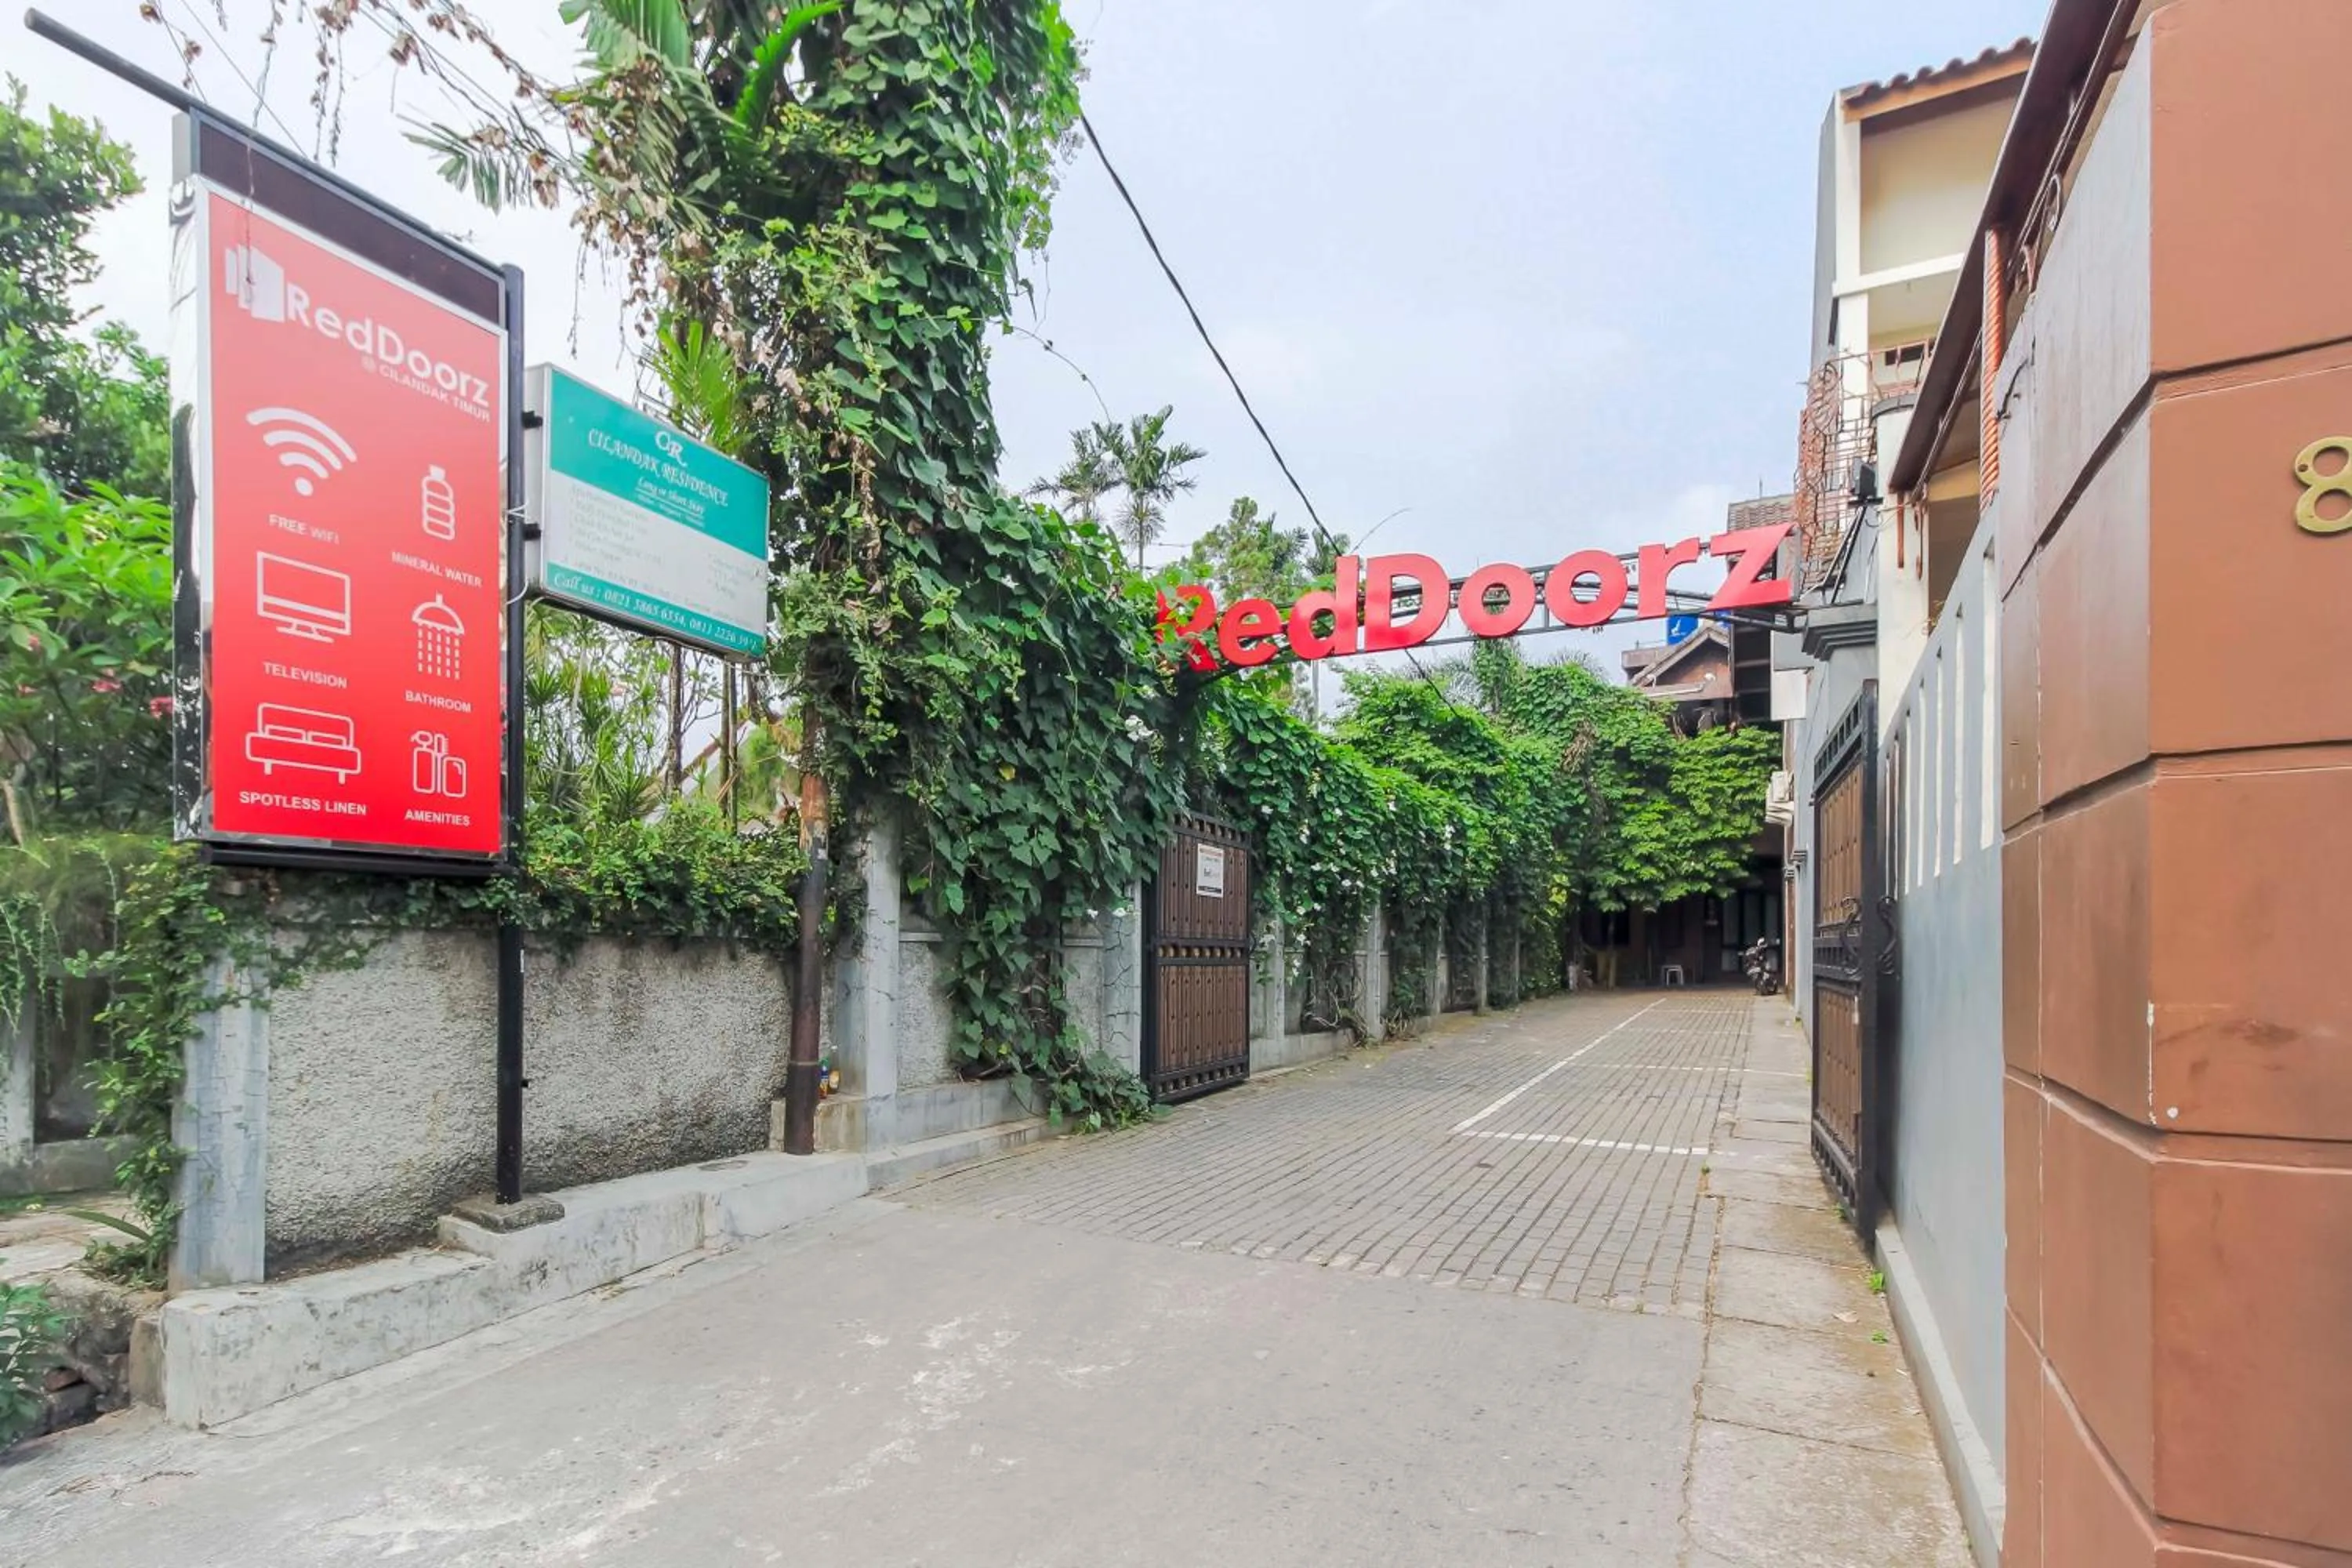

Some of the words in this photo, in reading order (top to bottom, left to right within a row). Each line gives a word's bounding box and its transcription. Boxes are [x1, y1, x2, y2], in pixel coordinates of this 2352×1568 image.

[287, 285, 490, 408] RedDoorz
[452, 395, 491, 423] TIMUR
[661, 463, 729, 507] RESIDENCE
[2295, 435, 2352, 533] 8
[268, 513, 307, 537] FREE
[391, 550, 443, 578] MINERAL
[445, 568, 483, 589] WATER
[1155, 522, 1795, 673] RedDoorz
[262, 661, 348, 690] TELEVISION
[404, 689, 472, 713] BATHROOM
[238, 790, 321, 812] SPOTLESS
[325, 800, 368, 817] LINEN
[404, 808, 471, 827] AMENITIES
